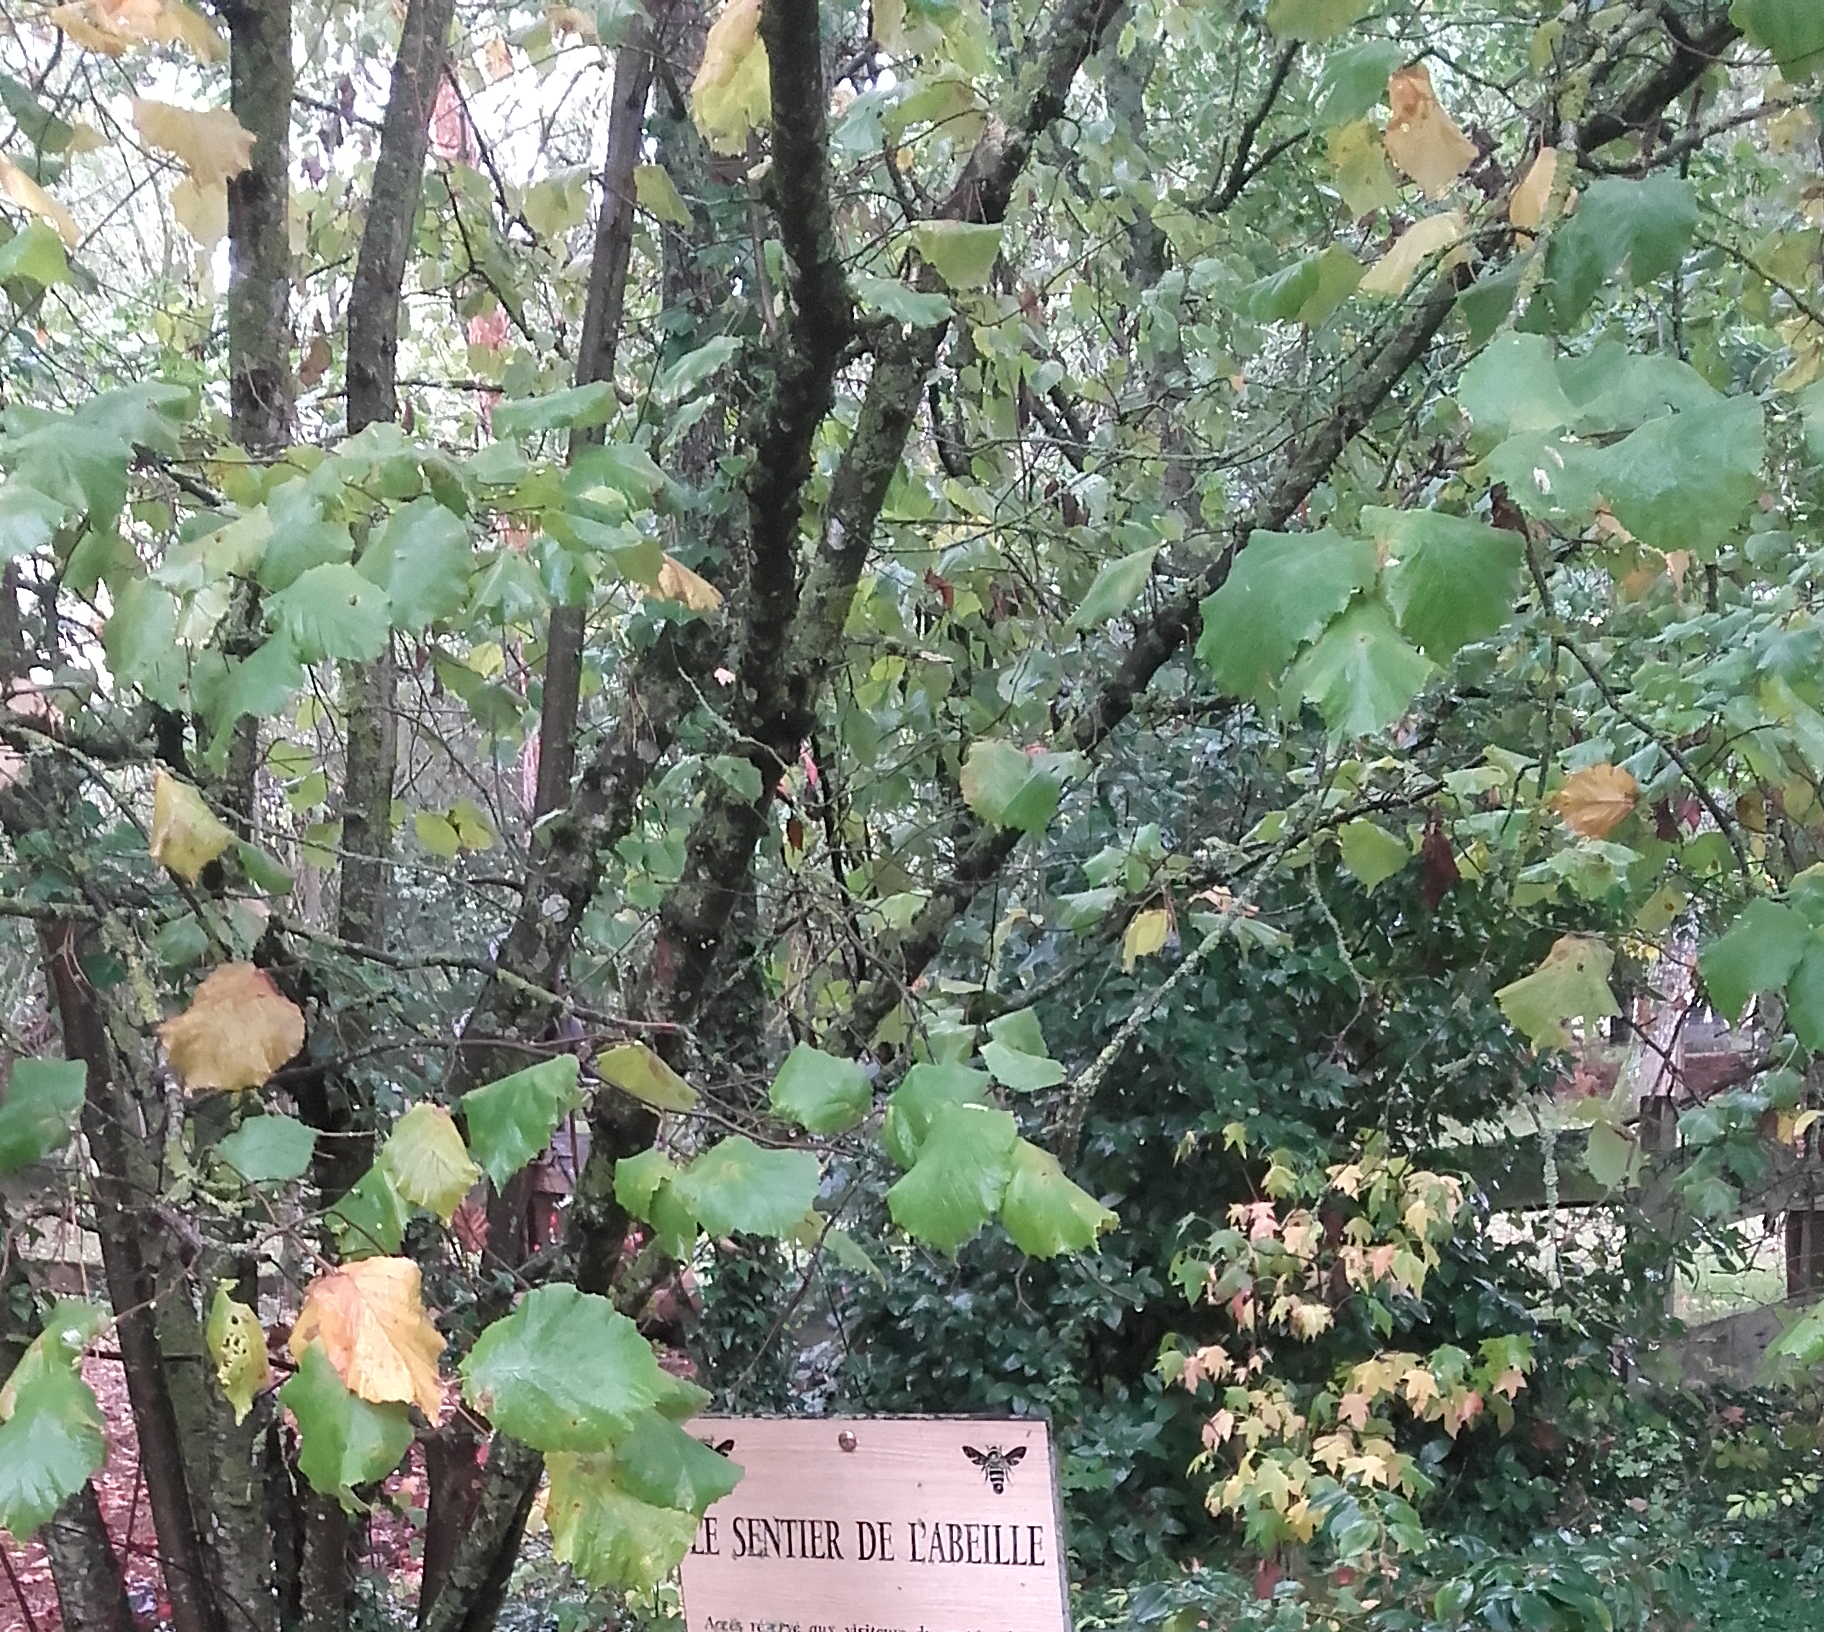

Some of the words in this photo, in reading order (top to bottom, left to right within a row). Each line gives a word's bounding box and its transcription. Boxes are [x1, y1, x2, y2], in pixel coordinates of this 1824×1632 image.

[732, 1516, 844, 1560] SENTIER
[856, 1520, 894, 1561] DE
[908, 1519, 1045, 1566] L'ABEILLE
